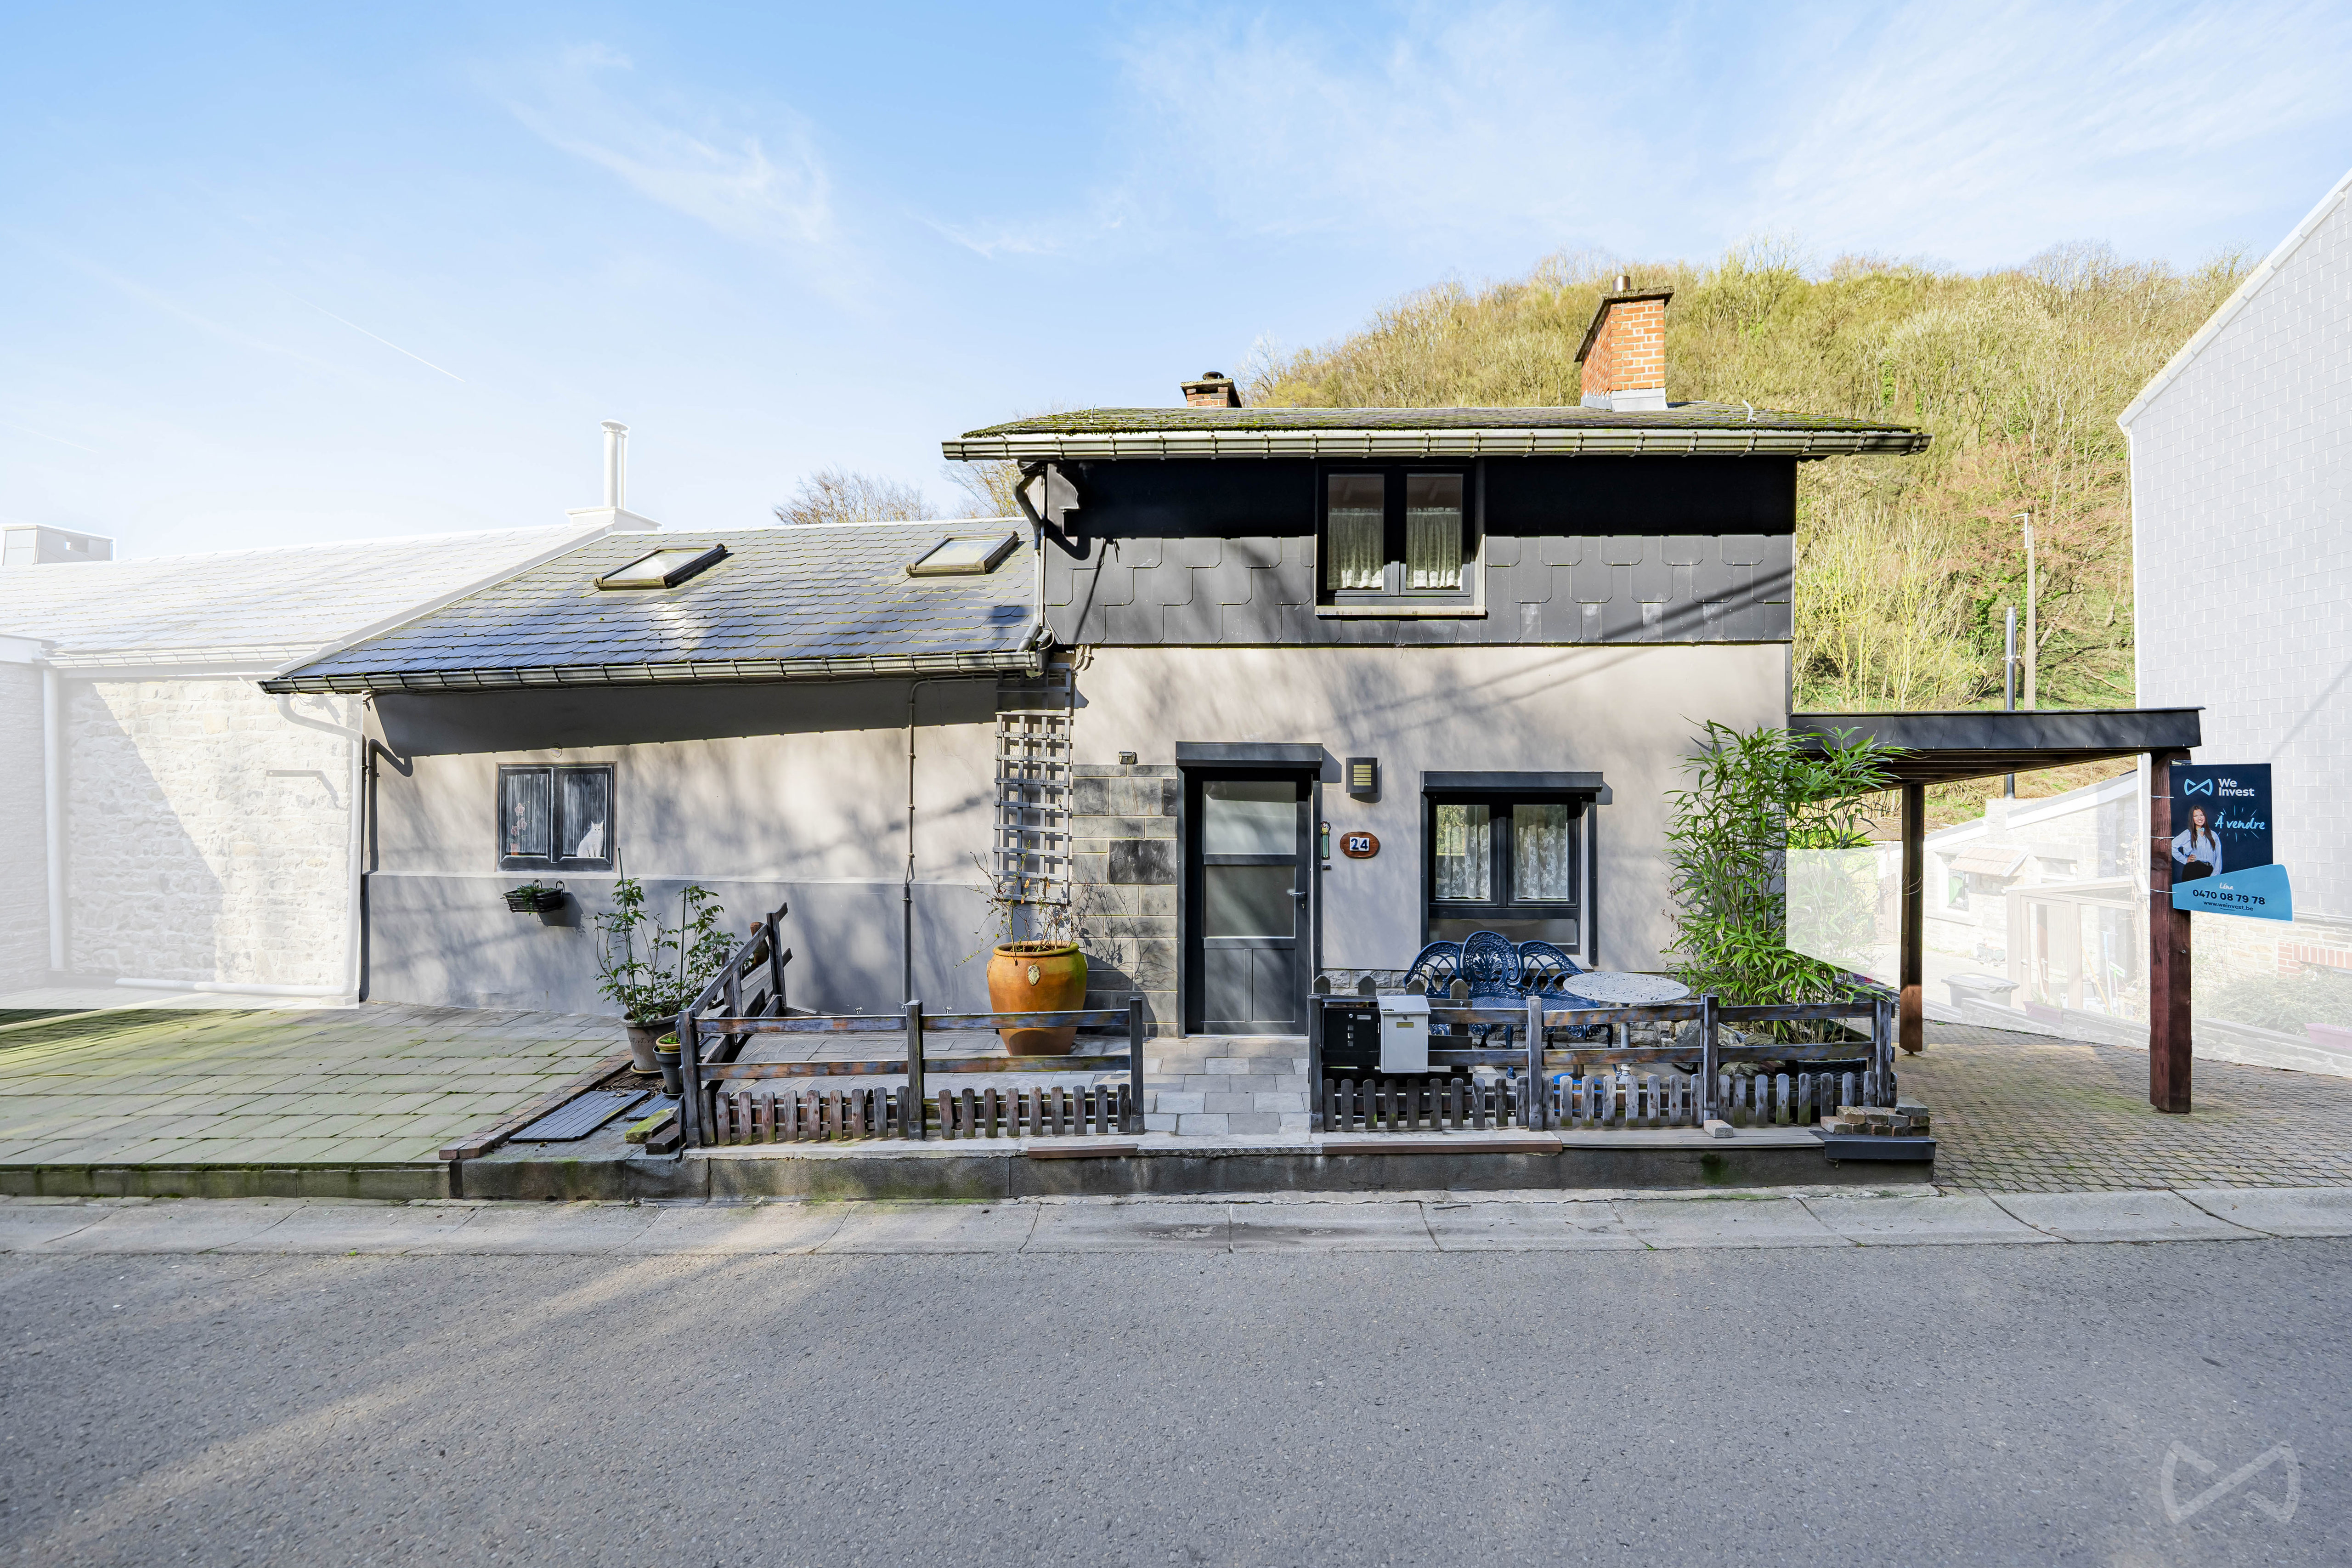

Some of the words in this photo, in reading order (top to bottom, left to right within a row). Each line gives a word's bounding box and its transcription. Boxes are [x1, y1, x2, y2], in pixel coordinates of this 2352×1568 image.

[2218, 778, 2237, 787] We
[2218, 787, 2255, 796] Invest
[2214, 811, 2224, 829] À
[2226, 817, 2265, 830] vendre
[1351, 838, 1368, 850] 24
[2219, 882, 2234, 890] Léna
[2193, 889, 2217, 899] 0470
[2220, 892, 2233, 901] 08
[2236, 894, 2249, 903] 79
[2251, 896, 2266, 905] 78
[2203, 901, 2253, 911] www.weinvest.be
